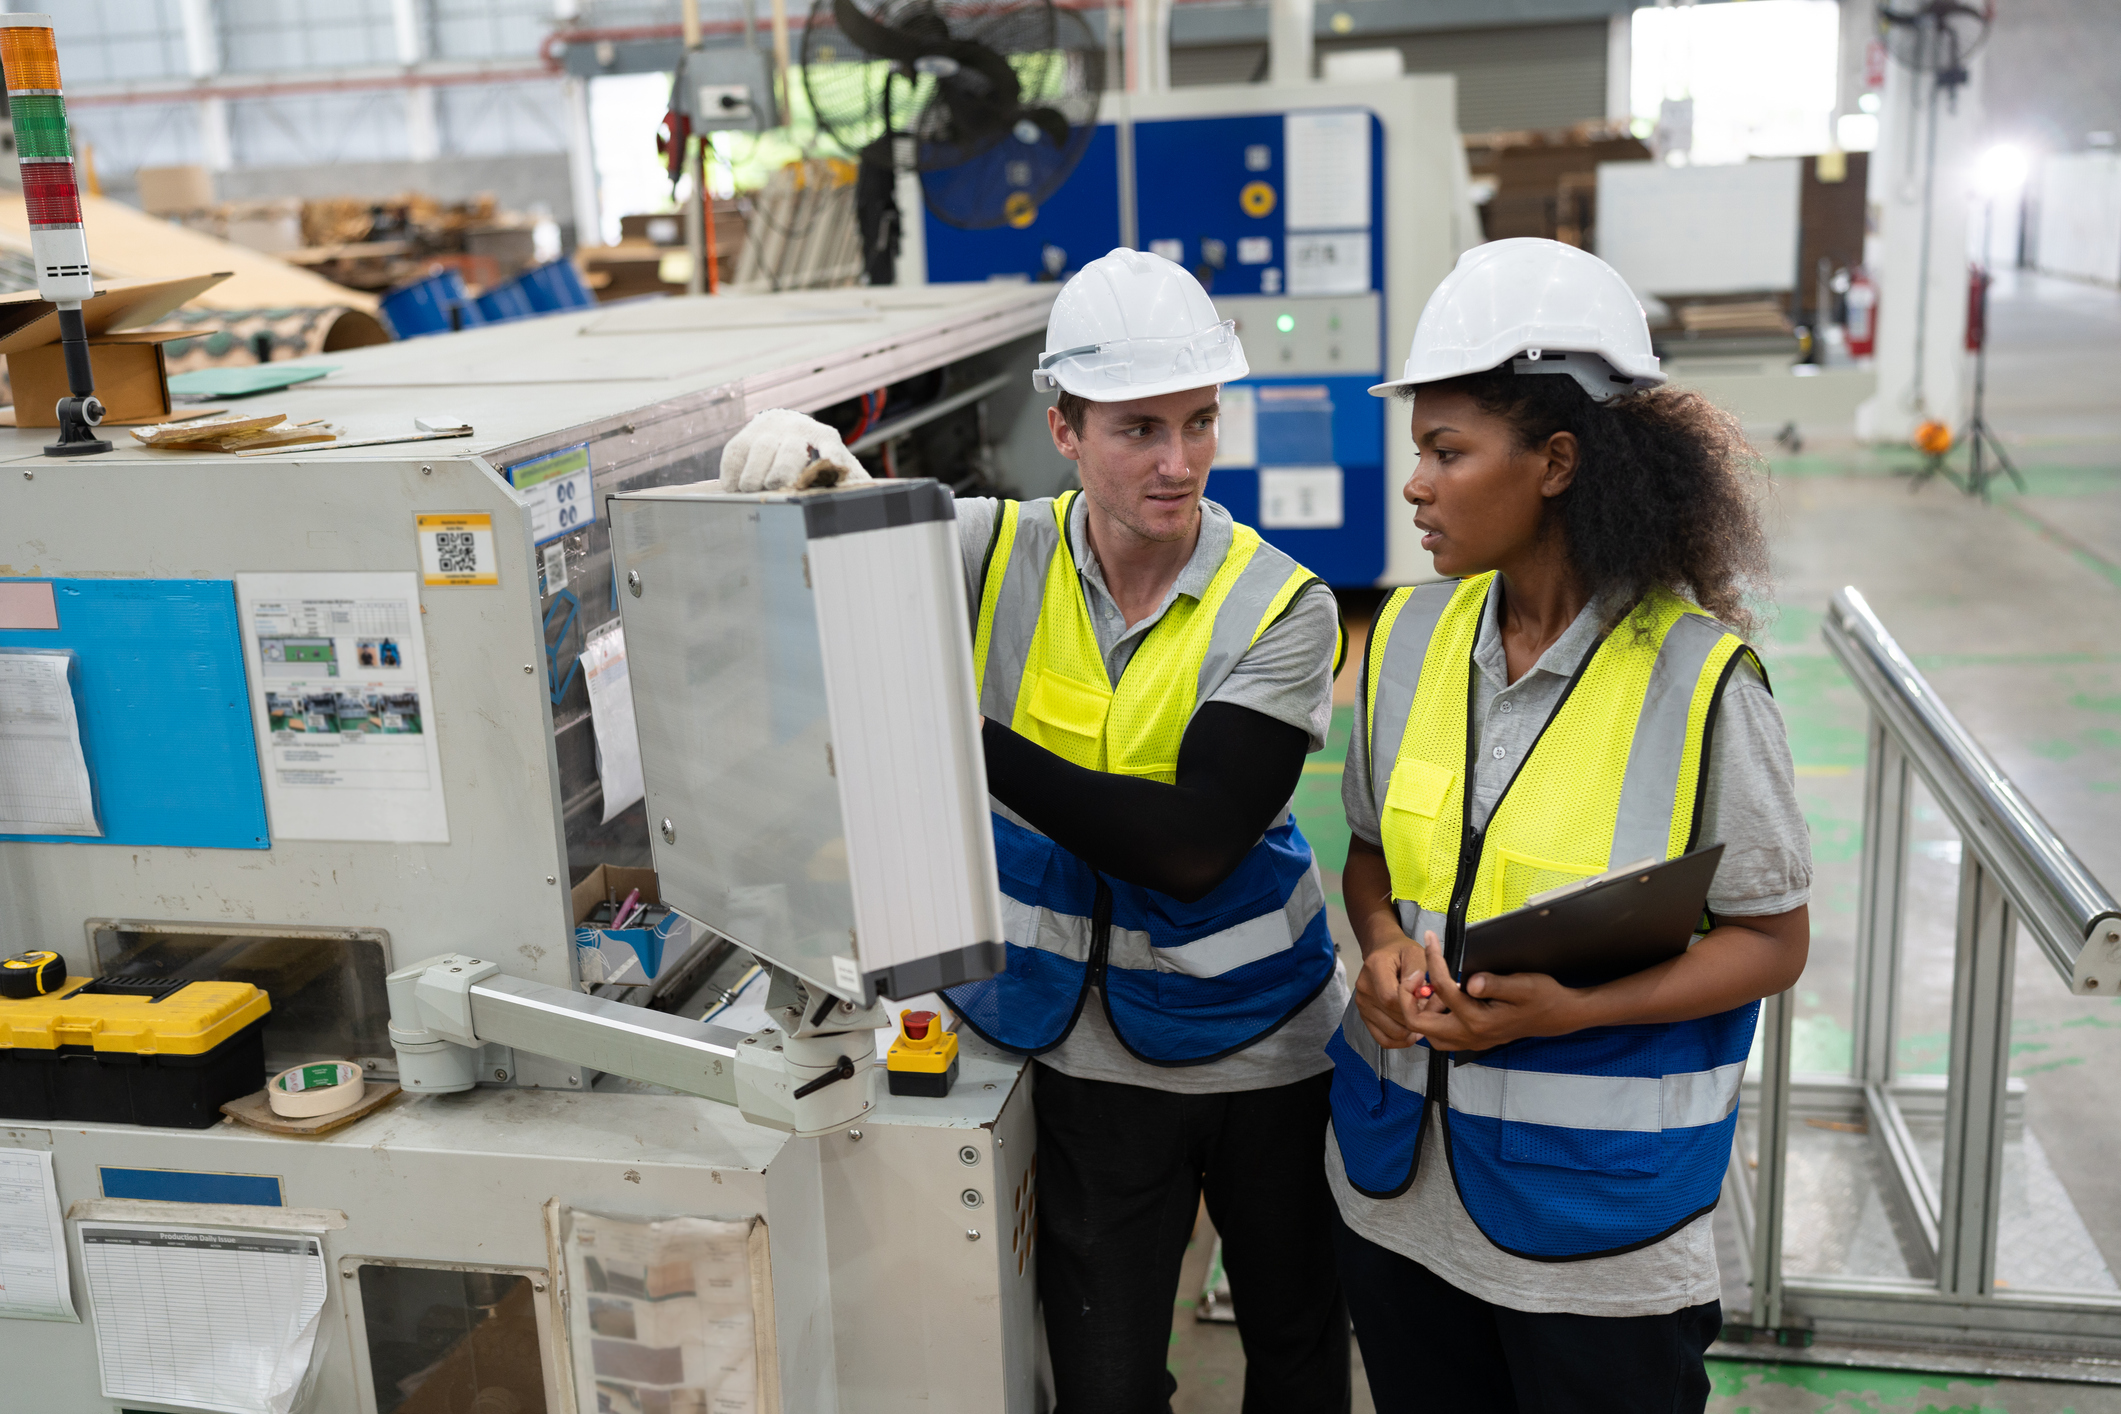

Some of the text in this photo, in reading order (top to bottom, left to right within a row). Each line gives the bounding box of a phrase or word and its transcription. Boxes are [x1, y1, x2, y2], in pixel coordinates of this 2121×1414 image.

[160, 1232, 236, 1244] Production Daily Issue
